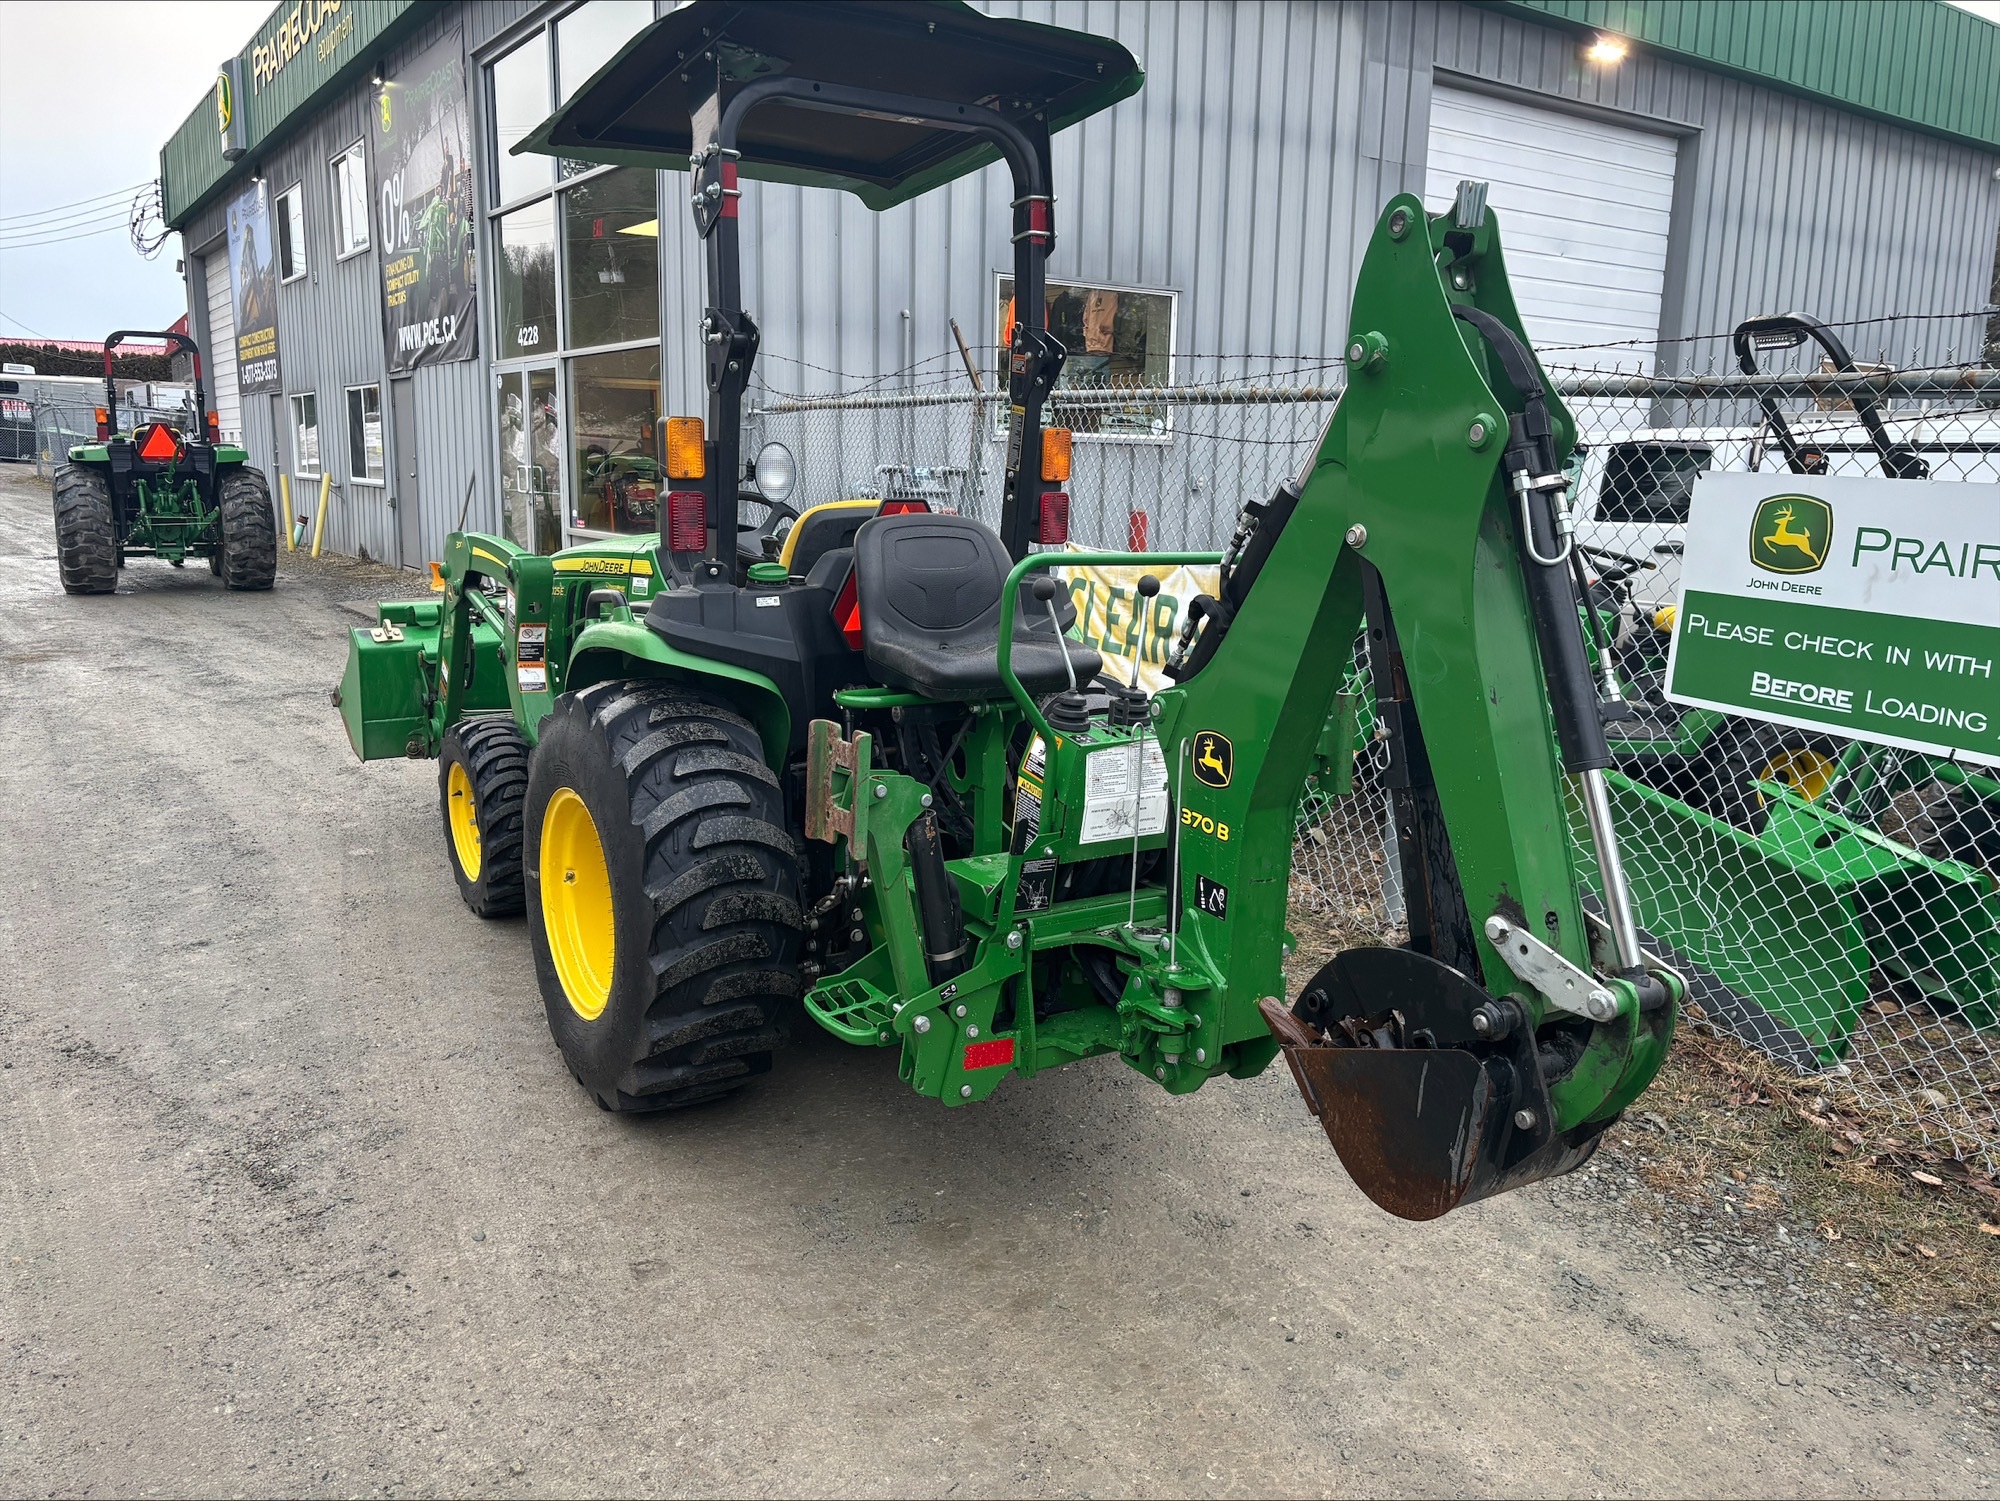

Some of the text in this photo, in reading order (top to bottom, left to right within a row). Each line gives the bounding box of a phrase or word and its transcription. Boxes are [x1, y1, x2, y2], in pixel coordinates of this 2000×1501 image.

[318, 11, 354, 64] equipment
[382, 168, 410, 255] 0%
[399, 315, 457, 351] WWW.PCE.CA
[517, 326, 539, 346] 4228
[580, 560, 624, 574] JOHN DEERE
[1747, 578, 1823, 595] JOHN DEERE
[1688, 613, 1992, 678] PLEASE CHECK IN WITH
[1751, 671, 1988, 732] BEFORE LOADING
[1025, 783, 1042, 799] CAUTIO
[1181, 807, 1230, 842] 370 B
